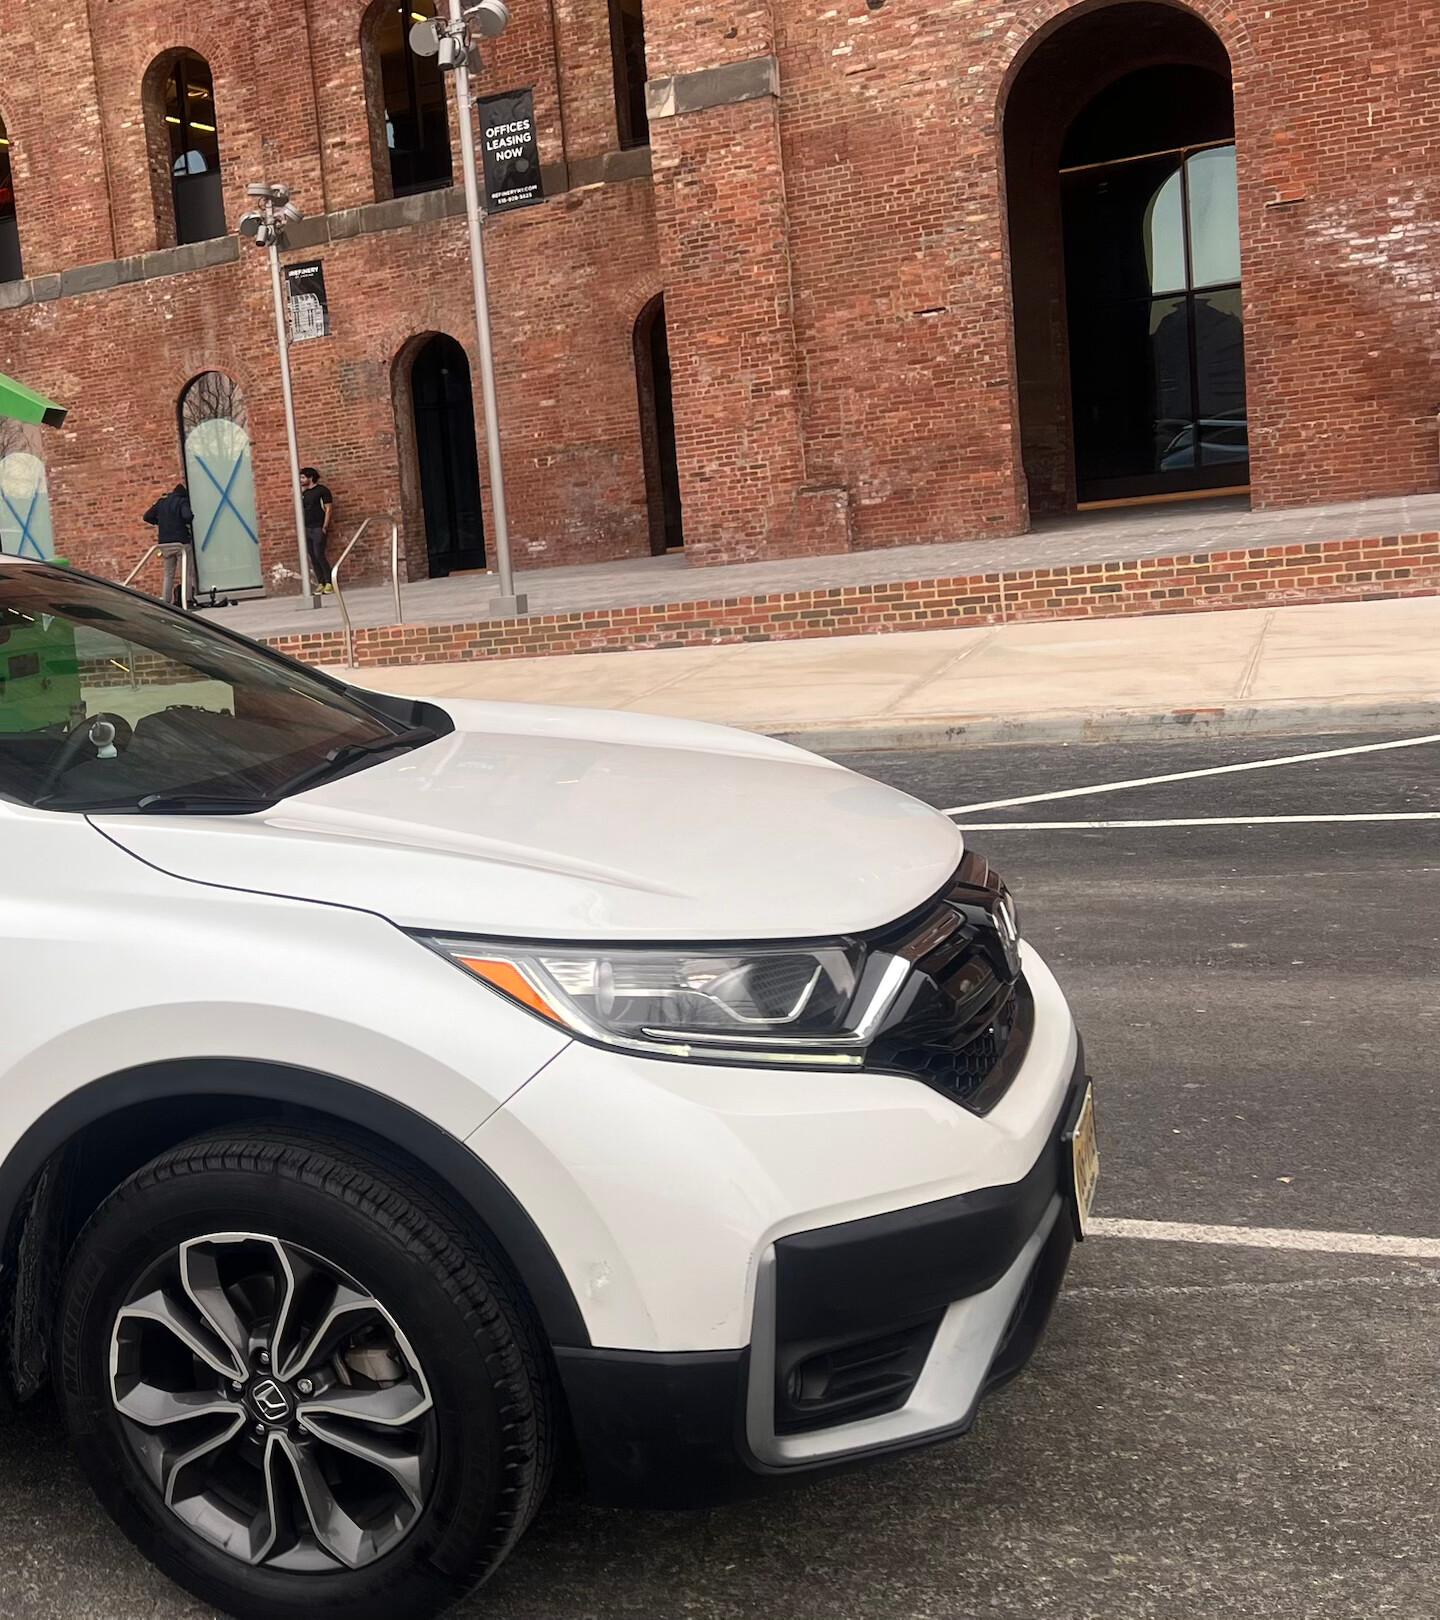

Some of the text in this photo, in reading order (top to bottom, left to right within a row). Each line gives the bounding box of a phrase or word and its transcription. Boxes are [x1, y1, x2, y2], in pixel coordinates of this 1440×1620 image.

[486, 120, 531, 138] OFFICES
[486, 133, 531, 151] LEASING
[496, 147, 523, 161] NOW
